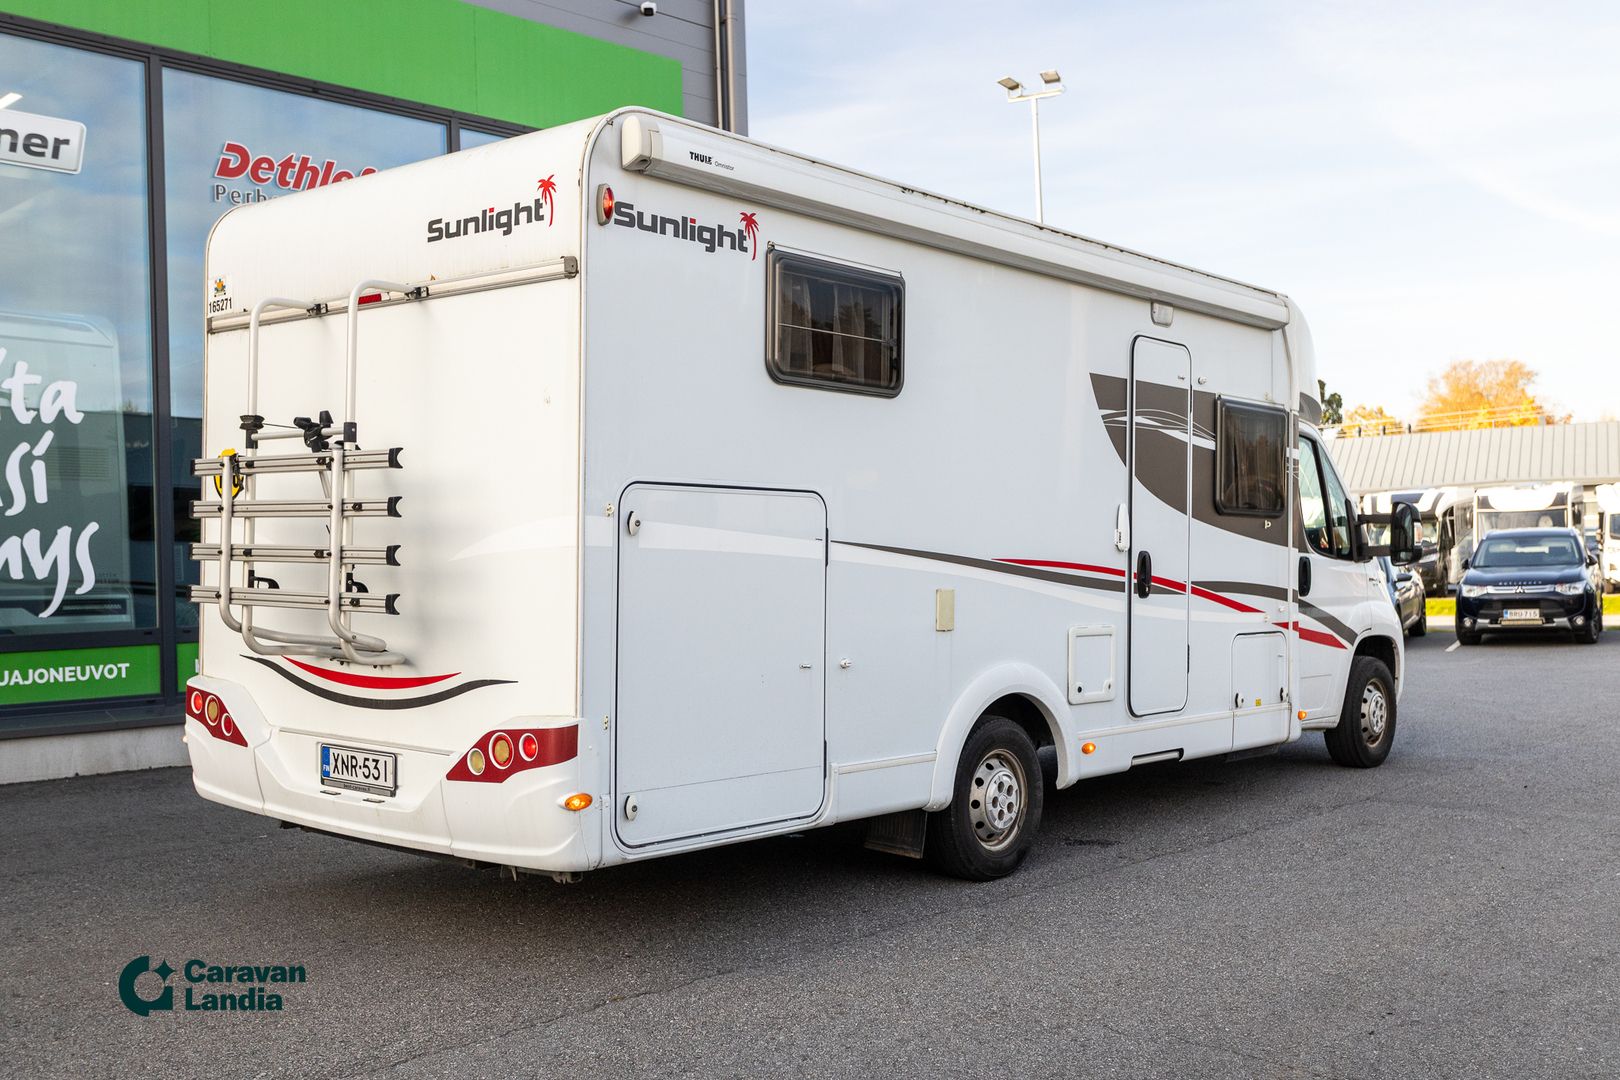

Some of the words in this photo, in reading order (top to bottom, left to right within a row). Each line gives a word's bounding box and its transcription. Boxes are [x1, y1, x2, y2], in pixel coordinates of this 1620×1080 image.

[689, 151, 713, 166] THULE
[427, 198, 545, 243] Sunlight
[613, 201, 748, 253] Sunlight
[209, 297, 232, 314] 165271
[332, 752, 388, 783] XNR-531
